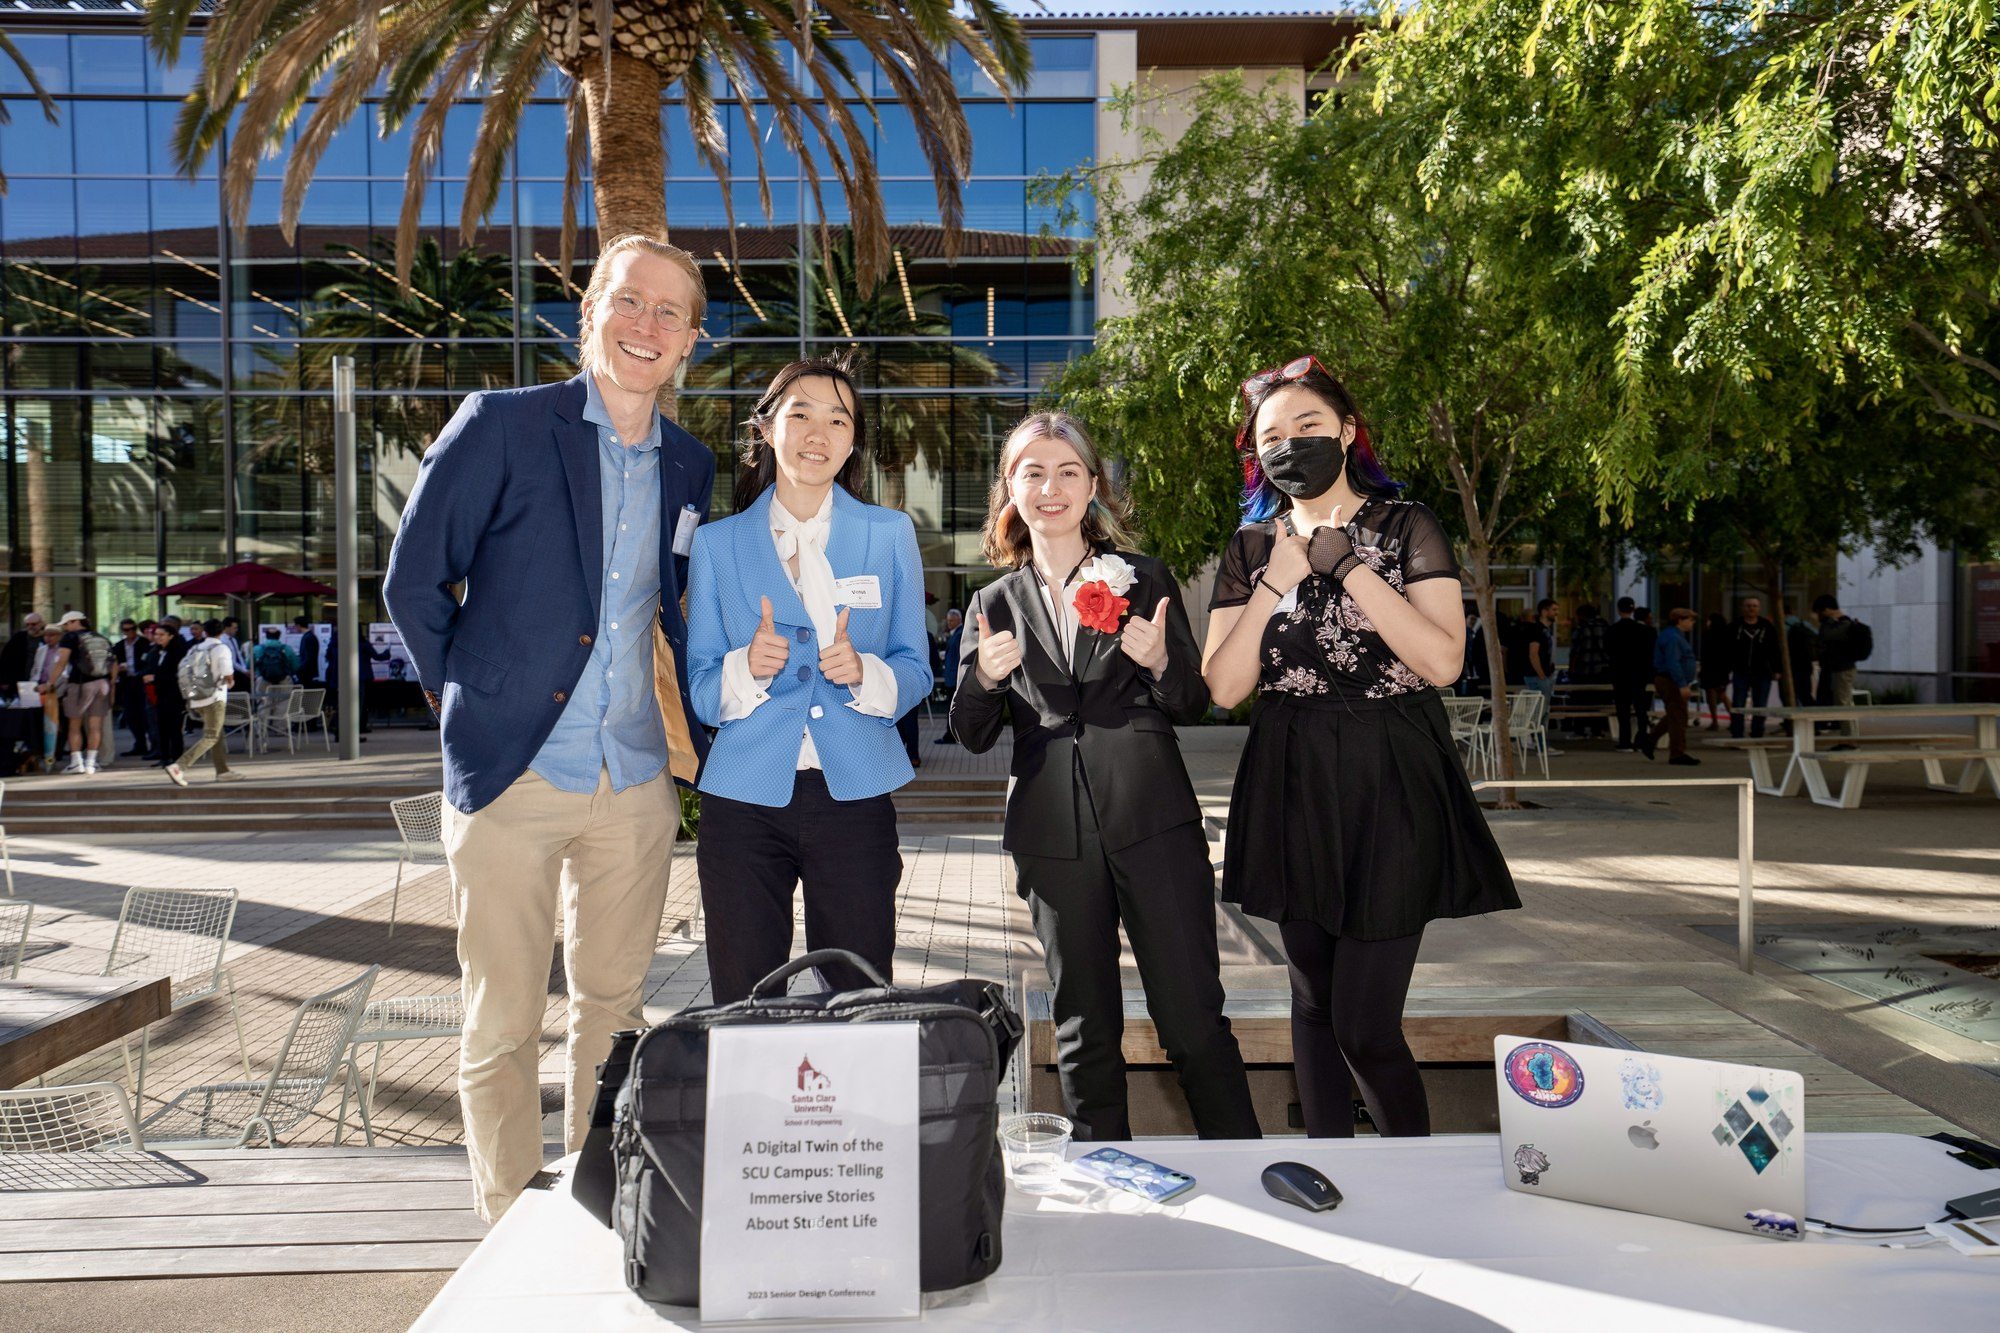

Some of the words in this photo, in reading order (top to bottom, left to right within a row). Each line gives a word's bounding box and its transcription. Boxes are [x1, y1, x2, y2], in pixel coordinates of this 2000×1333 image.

[791, 1095, 813, 1103] Santa
[815, 1094, 836, 1103] Clara
[794, 1104, 833, 1114] University
[810, 1118, 843, 1127] Engineering
[742, 1142, 753, 1154] A
[757, 1140, 801, 1157] Digital
[805, 1140, 839, 1152] Twin
[843, 1138, 857, 1152] of
[861, 1138, 884, 1151] the
[742, 1166, 769, 1179] SCU
[774, 1165, 833, 1180] Campus:
[837, 1163, 884, 1179] Telling
[750, 1190, 822, 1204] Immersive
[827, 1188, 875, 1203] Stories
[746, 1216, 789, 1231] About
[793, 1215, 848, 1229] Student
[853, 1213, 878, 1228] Life
[748, 1291, 768, 1299] 2023
[770, 1290, 796, 1299] Senior
[799, 1288, 827, 1299] Design
[828, 1288, 876, 1298] Conference
